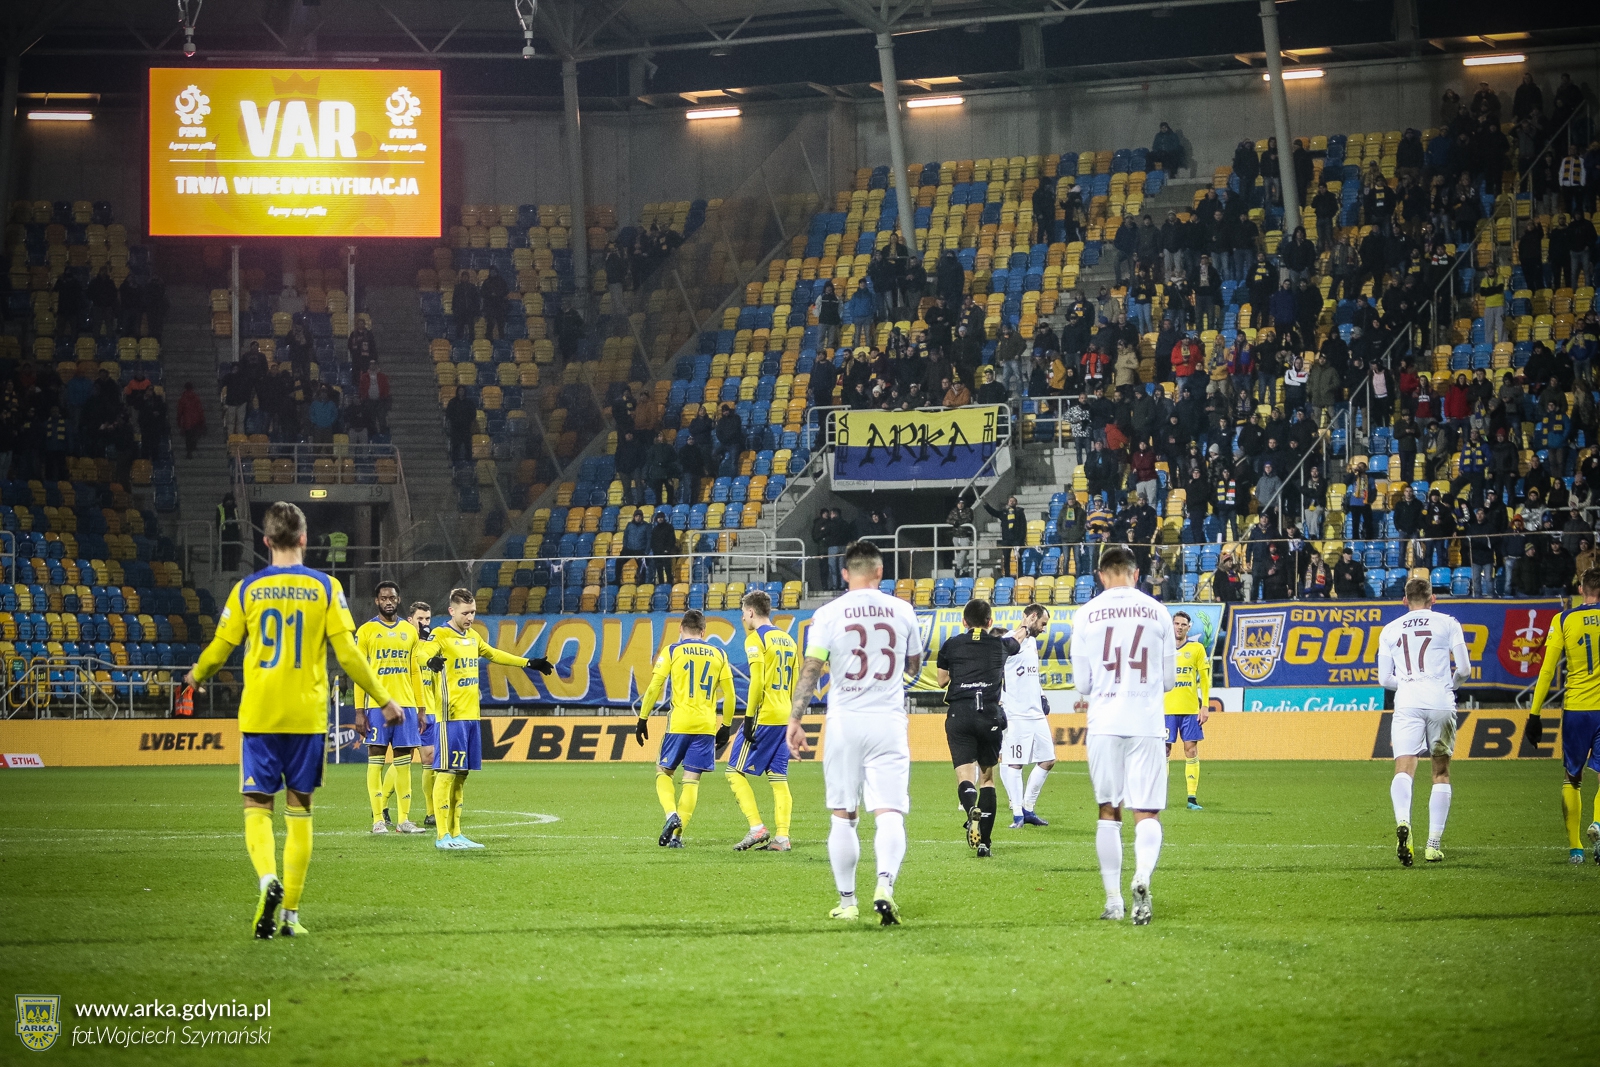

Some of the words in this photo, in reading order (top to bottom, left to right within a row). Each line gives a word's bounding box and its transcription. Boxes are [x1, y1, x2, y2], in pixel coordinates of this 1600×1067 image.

[240, 100, 357, 157] VAR
[175, 176, 228, 195] TRWA
[233, 176, 419, 195] WIDEOWERYFIKACJA
[859, 421, 975, 467] ARKA
[250, 586, 319, 601] SERRARENS
[844, 605, 895, 619] GULDAN
[1088, 603, 1158, 624] CZERWIŃSKI
[1290, 607, 1382, 622] GDYŃSKA
[1403, 618, 1430, 629] SZYSZ
[259, 608, 303, 669] 91
[683, 647, 715, 657] NALEPA
[844, 622, 897, 681] 33
[1102, 624, 1149, 684] 44
[1239, 649, 1272, 657] ARKA
[1396, 630, 1432, 676] 17
[377, 666, 409, 675] GDYNIA
[771, 649, 794, 691] 35
[683, 659, 713, 700] 14
[1303, 696, 1379, 712] Gdańsk
[139, 732, 225, 751] LVBET.PL
[370, 727, 378, 742] 3
[452, 750, 466, 768] 27
[1010, 744, 1023, 759] 18
[11, 757, 39, 765] STIHL
